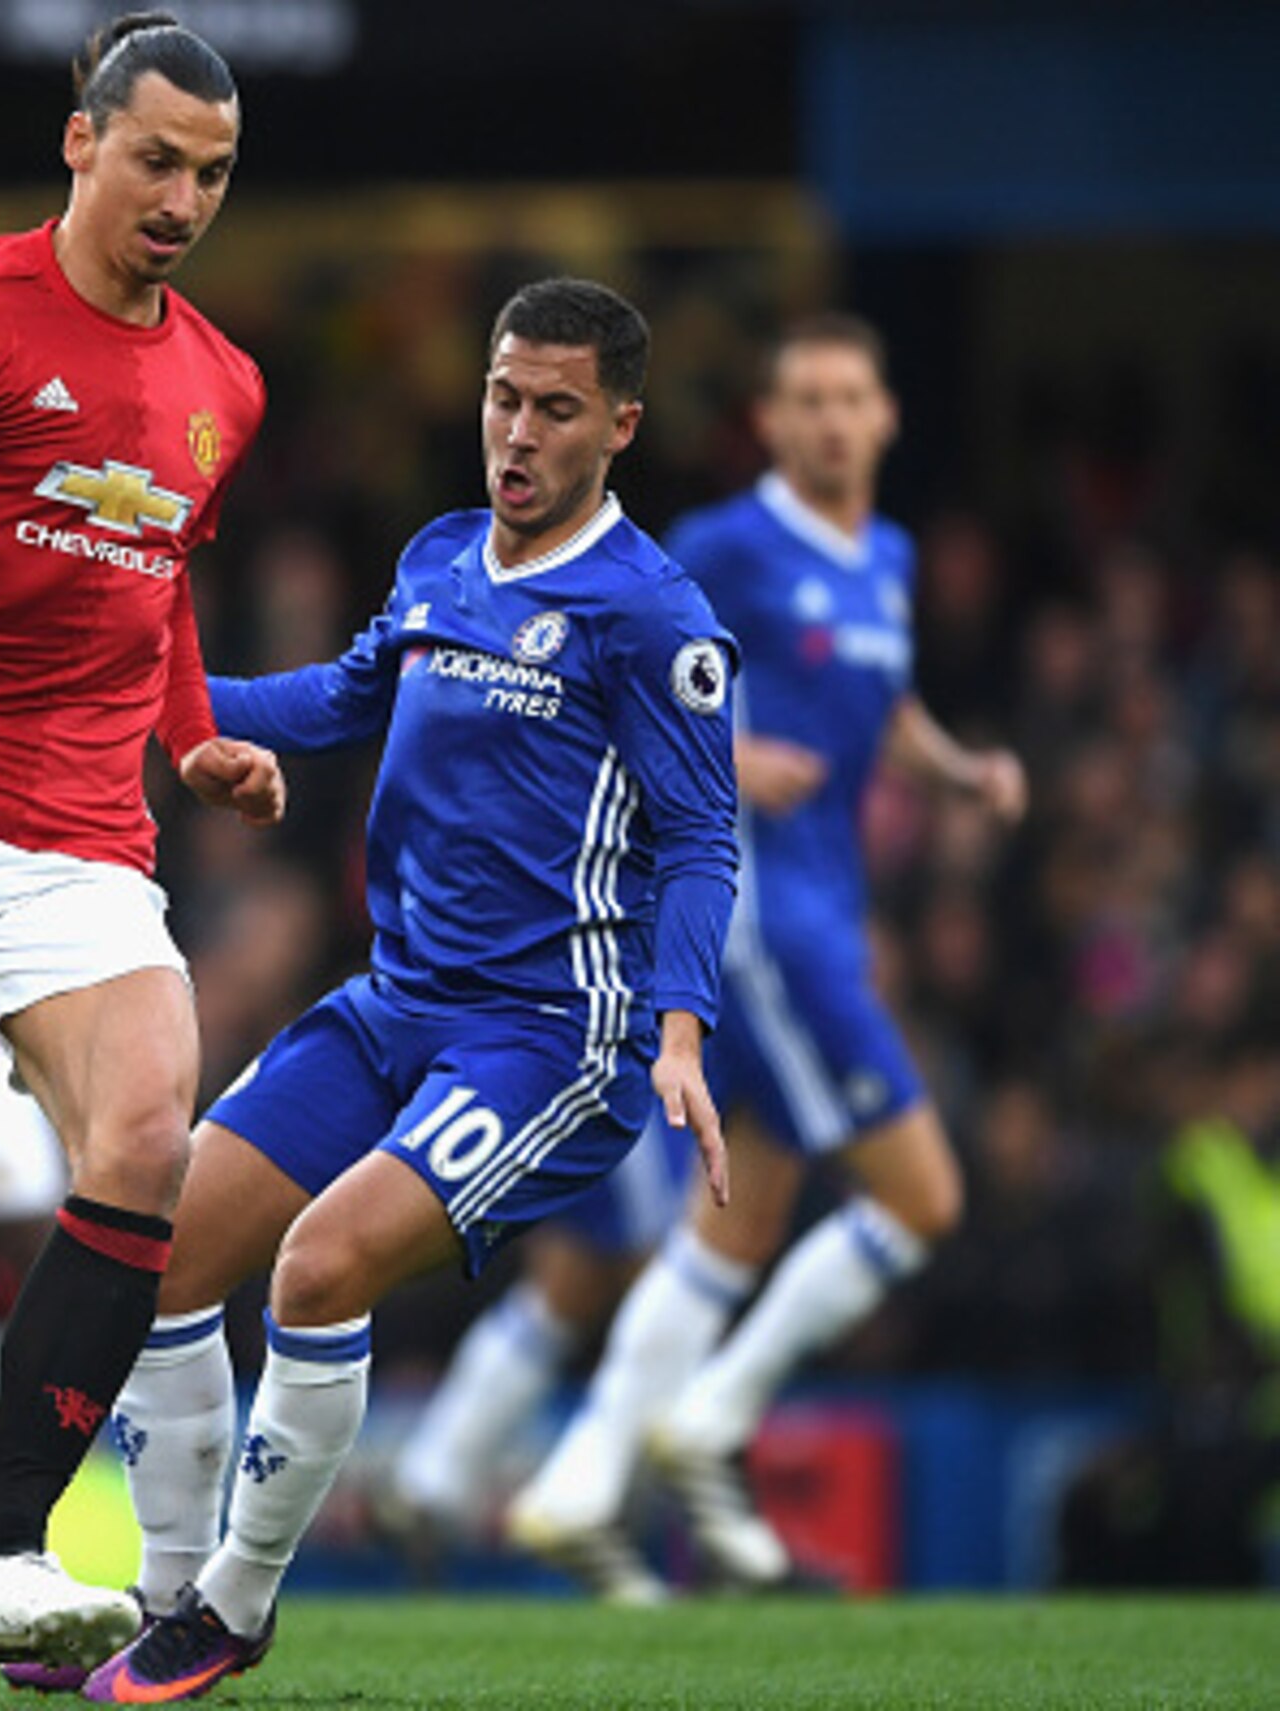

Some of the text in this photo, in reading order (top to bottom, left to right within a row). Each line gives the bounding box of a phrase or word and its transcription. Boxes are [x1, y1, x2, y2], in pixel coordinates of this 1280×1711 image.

[427, 647, 563, 694] YOKOHAMA
[483, 688, 561, 720] TYRES
[397, 1086, 503, 1182] 10
